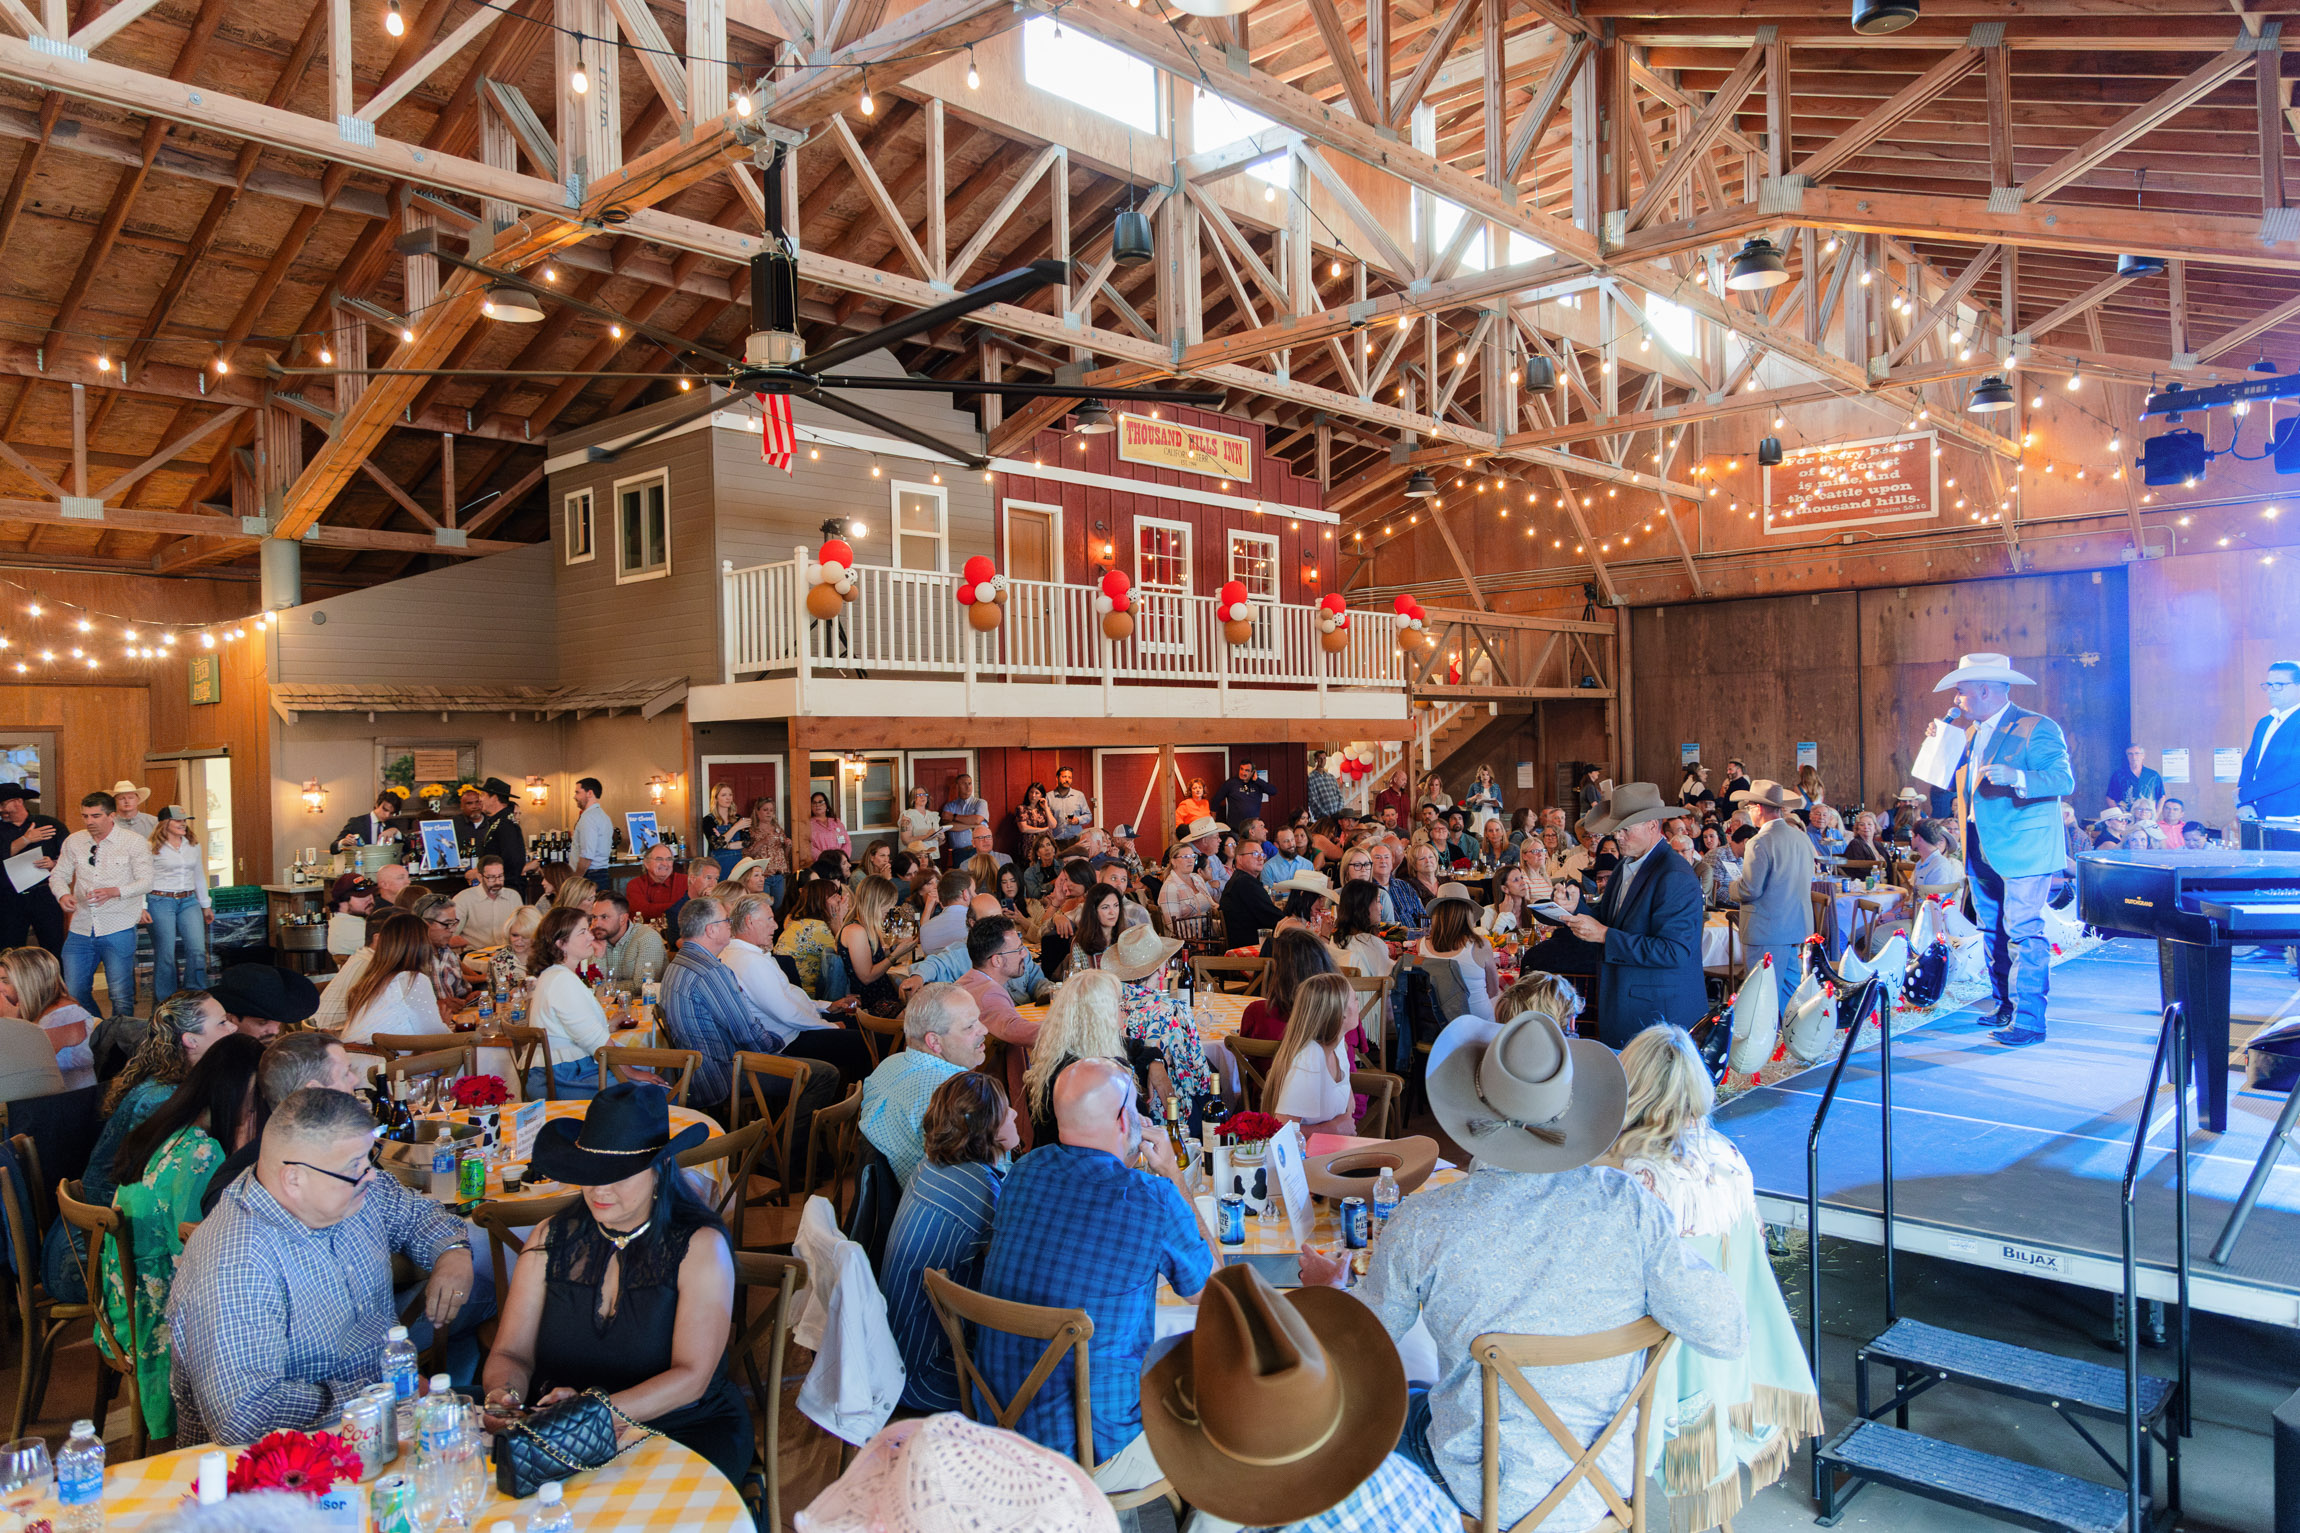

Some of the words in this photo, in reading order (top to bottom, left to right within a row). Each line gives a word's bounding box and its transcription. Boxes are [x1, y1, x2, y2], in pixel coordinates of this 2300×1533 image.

[1126, 420, 1182, 447] THOUSAND
[1188, 433, 1218, 457] HILLS
[1223, 440, 1243, 466] INN
[1163, 447, 1195, 461] CALIFOR
[1784, 456, 1815, 467] For
[1798, 467, 1816, 477] of
[1787, 493, 1814, 503] the
[1818, 487, 1863, 500] cattle
[1867, 482, 1913, 496] upon
[1798, 481, 1813, 490] is
[1796, 498, 1872, 515] thousand
[1875, 494, 1921, 507] hills.
[2003, 1246, 2058, 1266] BILJAX
